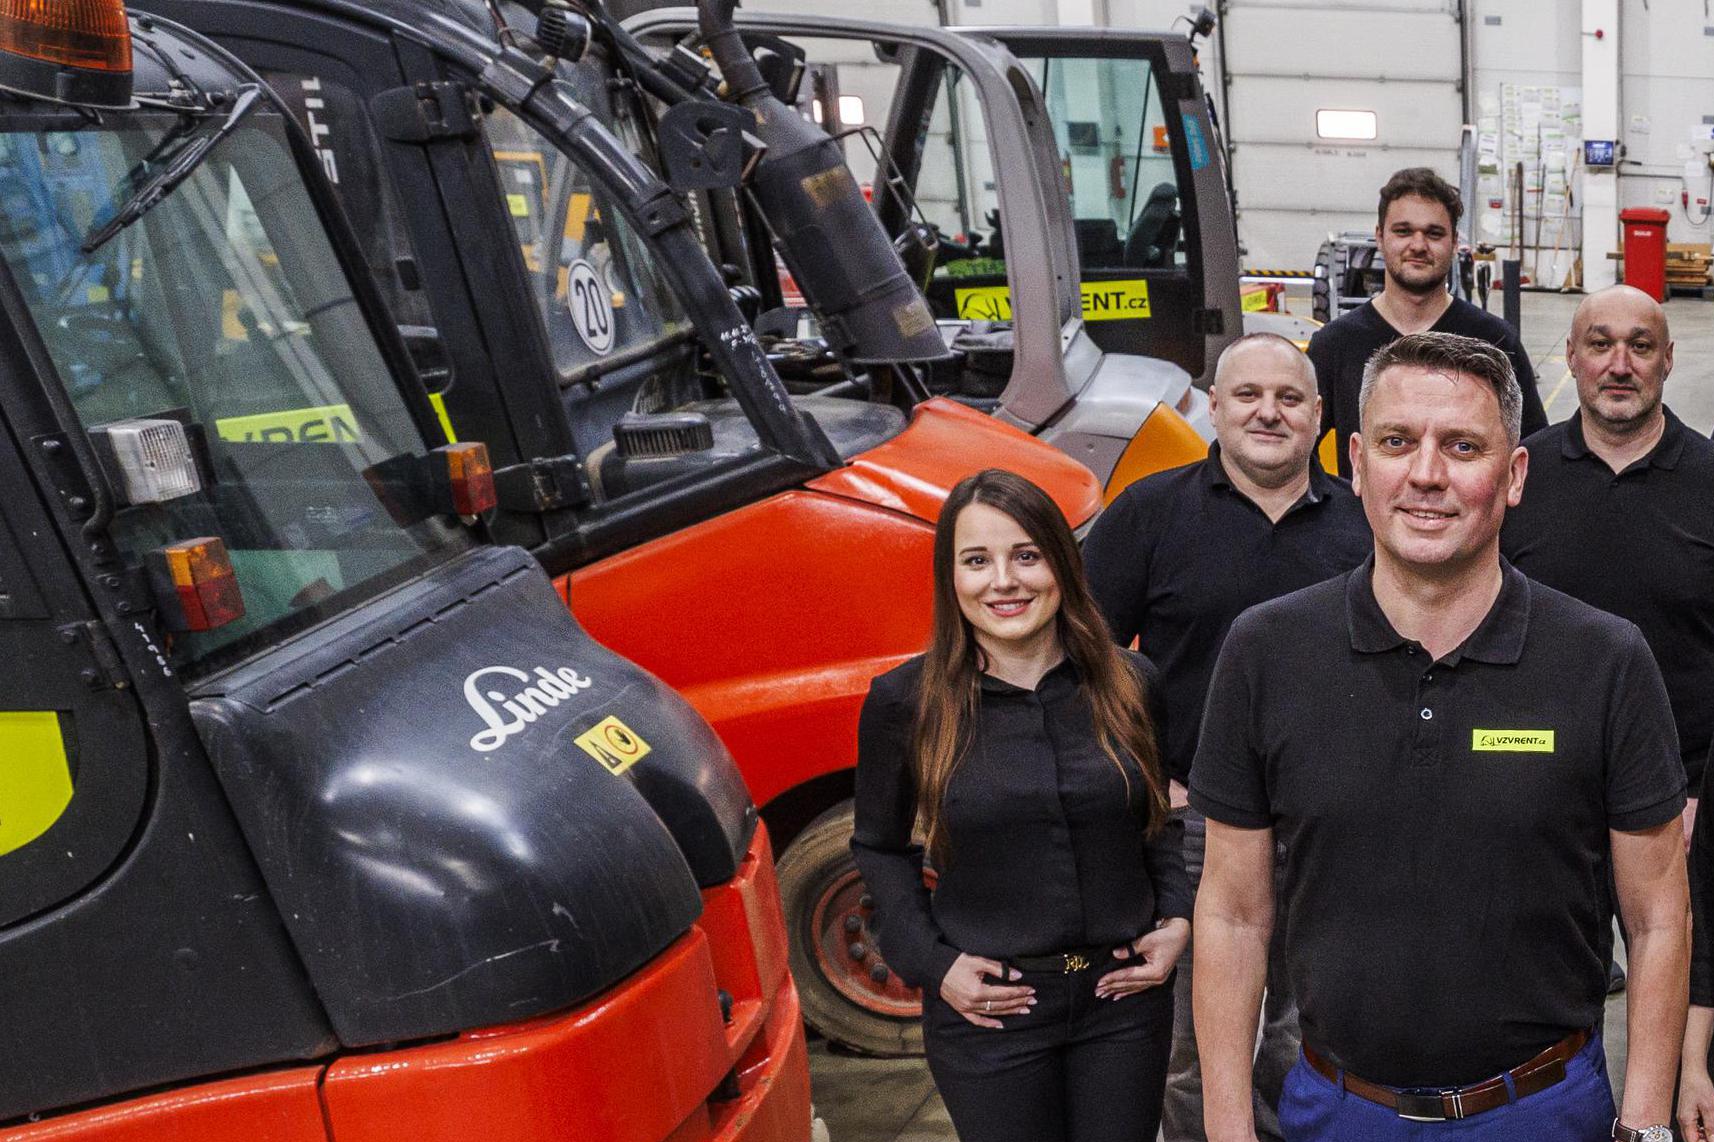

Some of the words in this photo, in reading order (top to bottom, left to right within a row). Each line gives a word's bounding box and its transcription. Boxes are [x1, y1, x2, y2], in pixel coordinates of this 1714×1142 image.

[575, 277, 608, 337] 20
[463, 665, 593, 752] Linde
[1496, 736, 1547, 745] VZVRENT.cz
